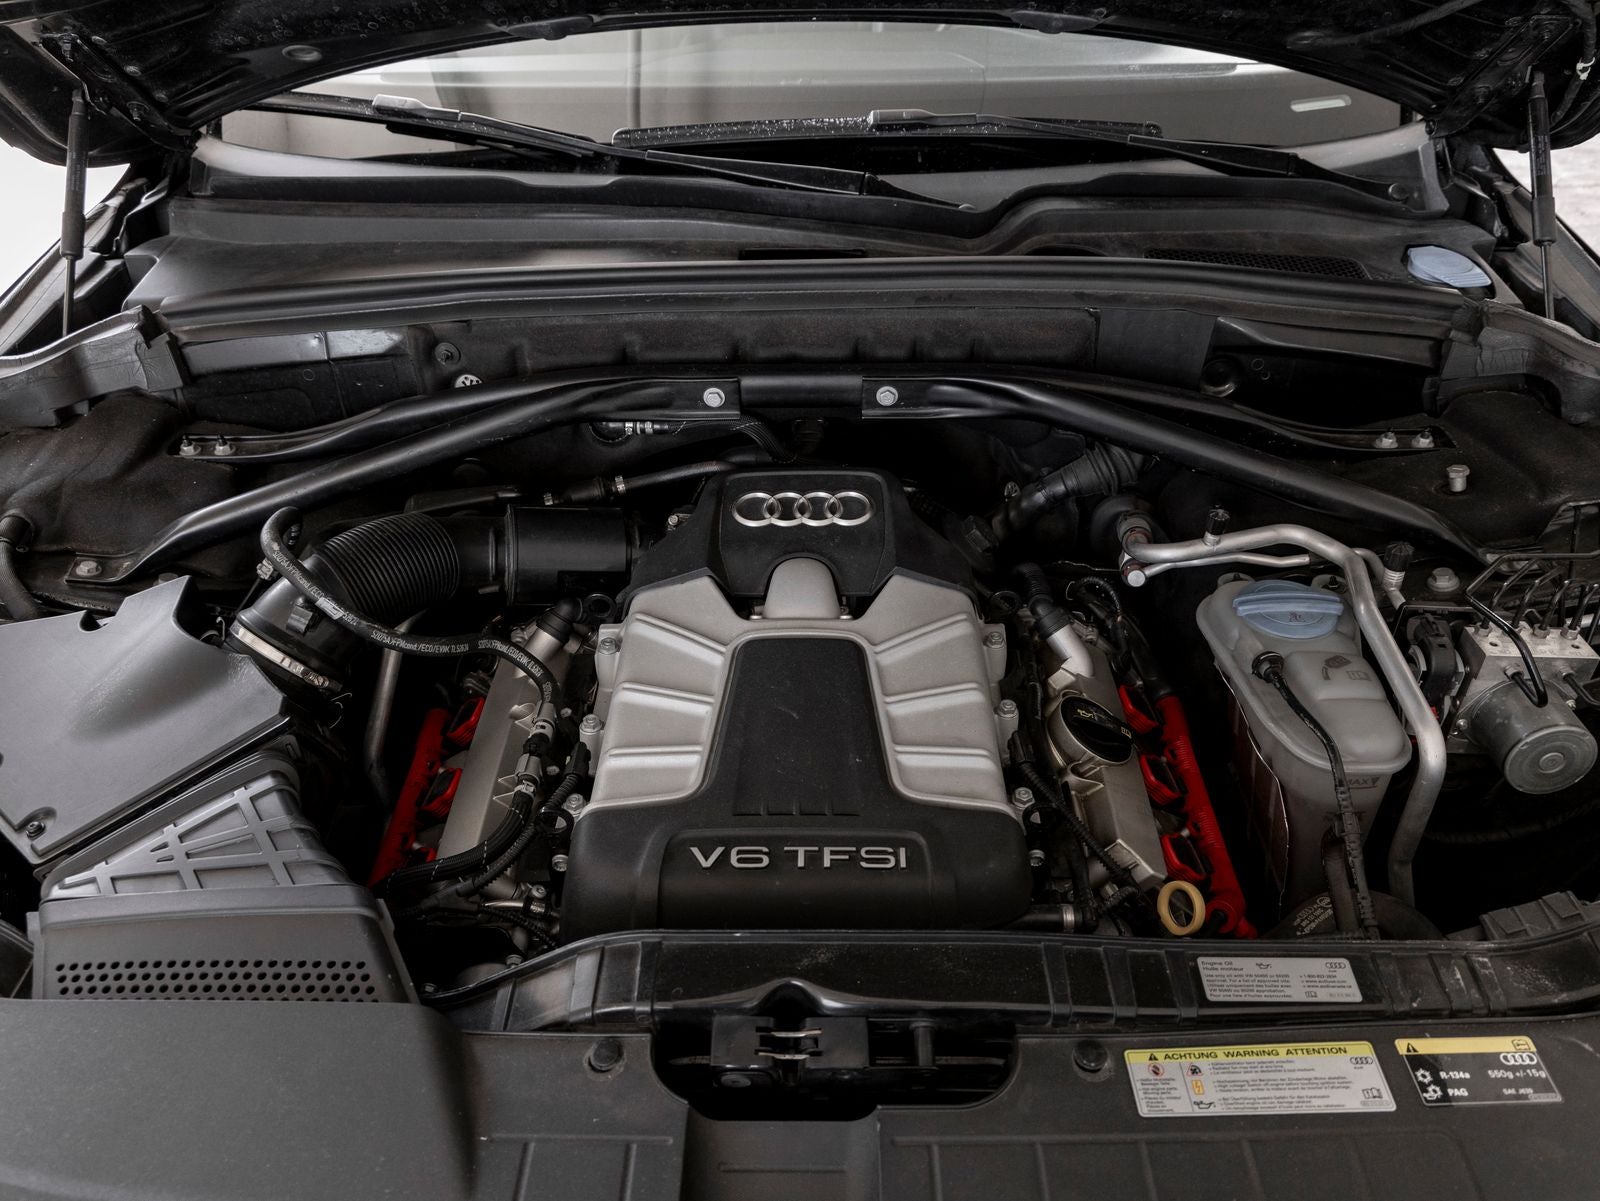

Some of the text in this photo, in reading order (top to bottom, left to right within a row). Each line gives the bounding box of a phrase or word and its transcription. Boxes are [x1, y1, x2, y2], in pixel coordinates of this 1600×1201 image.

[689, 846, 907, 869] V6 TFSI
[1164, 1046, 1347, 1060] ACHTUNG WARNING ATTENTION
[1440, 1071, 1471, 1080] R-134a
[1447, 1088, 1469, 1096] PAG
